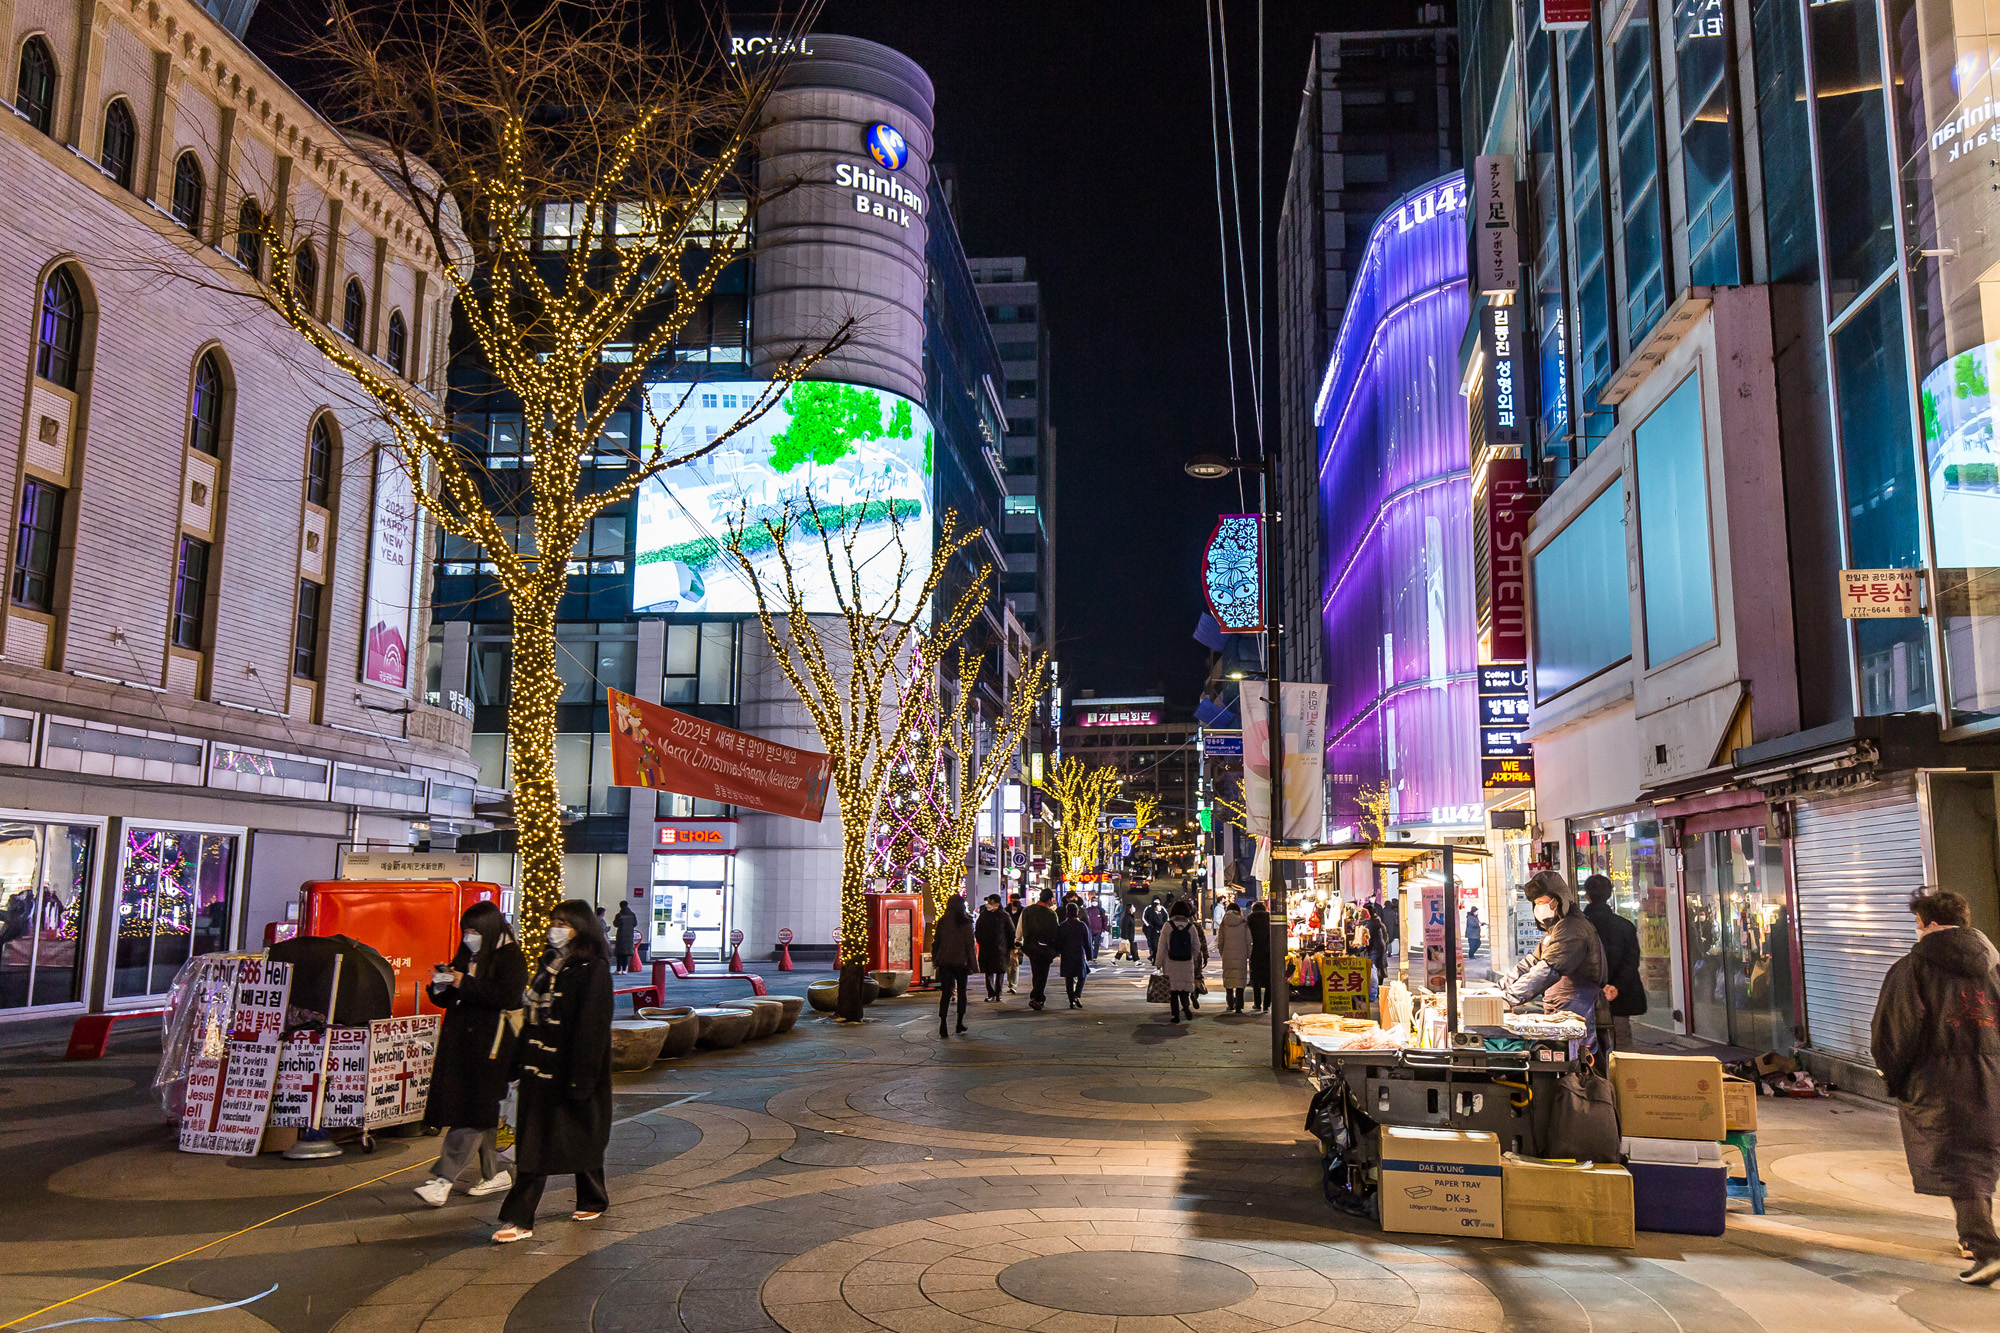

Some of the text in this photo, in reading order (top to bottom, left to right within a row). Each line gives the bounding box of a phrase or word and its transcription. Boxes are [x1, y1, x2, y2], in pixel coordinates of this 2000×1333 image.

[731, 37, 814, 55] ROYAL
[835, 162, 923, 216] Shinhan
[855, 193, 911, 230] Bank
[1488, 202, 1506, 221] 足
[1495, 360, 1516, 428] 성형외과
[385, 499, 406, 517] 2022
[379, 513, 409, 535] HAPPY
[382, 531, 405, 550] NEW
[380, 546, 405, 566] YEAR
[1848, 582, 1913, 603] 부동산
[1852, 606, 1891, 614] 777-6644
[1484, 671, 1510, 679] Coffee
[670, 716, 711, 747] 2022년
[714, 729, 742, 752] 새해
[736, 735, 748, 757] 복
[746, 739, 766, 759] 많이
[656, 736, 692, 768] Merry
[1501, 760, 1519, 772] WE
[1491, 772, 1532, 782] 시계거래소
[678, 830, 724, 843] 다이소
[263, 960, 288, 986] Hell
[1327, 970, 1365, 993] 全身
[241, 988, 283, 1008] 베리칩
[235, 1009, 254, 1035] 영원
[254, 1011, 283, 1035] 불지옥
[373, 1047, 405, 1065] Verichip
[278, 1058, 316, 1073] erichip
[342, 1058, 365, 1072] Hell
[187, 1090, 215, 1102] Jesus
[272, 1091, 285, 1103] ord
[286, 1092, 308, 1103] Jesus
[338, 1092, 365, 1104] Jesus
[273, 1104, 301, 1115] Heaven
[334, 1104, 353, 1115] Hell
[1418, 1163, 1465, 1173] DAE KYUNG
[1434, 1179, 1482, 1189] PAPER TRAY
[1445, 1193, 1471, 1204] DK-3
